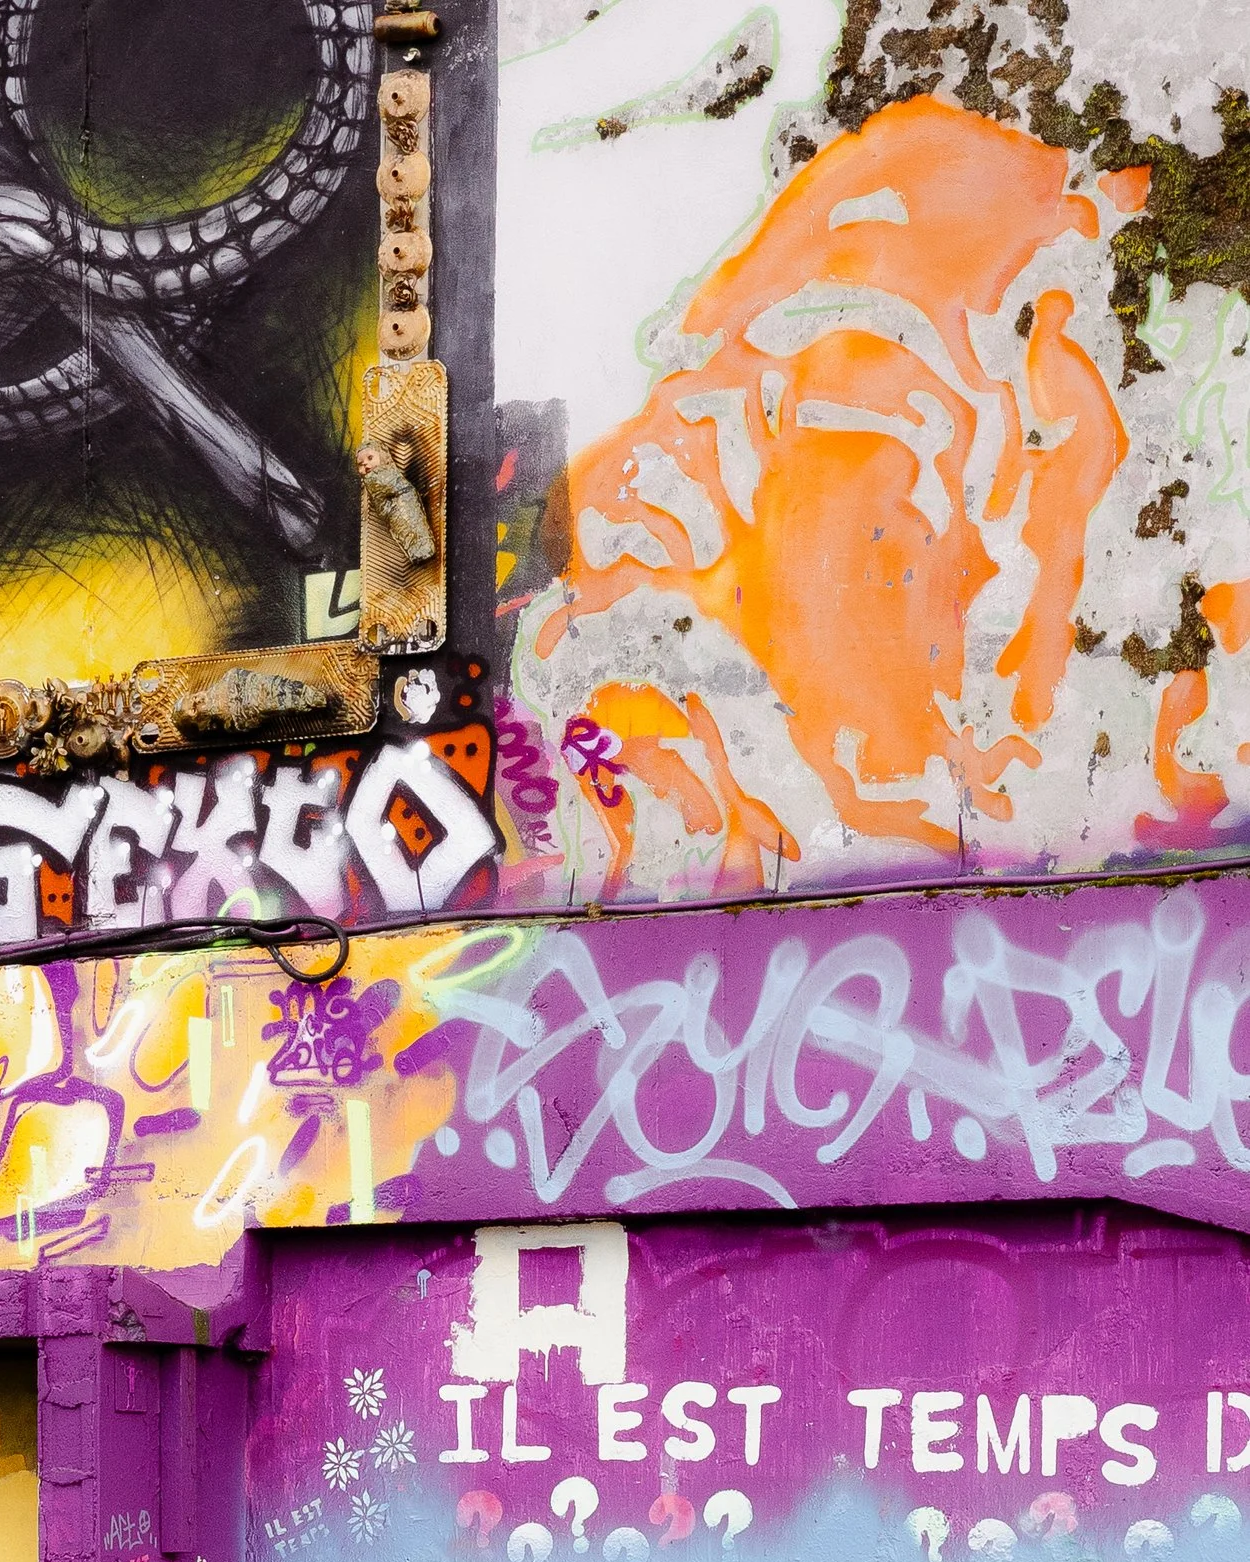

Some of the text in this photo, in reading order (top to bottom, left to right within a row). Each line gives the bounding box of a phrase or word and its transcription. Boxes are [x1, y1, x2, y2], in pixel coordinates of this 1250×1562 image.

[438, 1383, 552, 1464] IL
[597, 1381, 783, 1466] EST
[846, 1387, 1161, 1487] TEMPS
